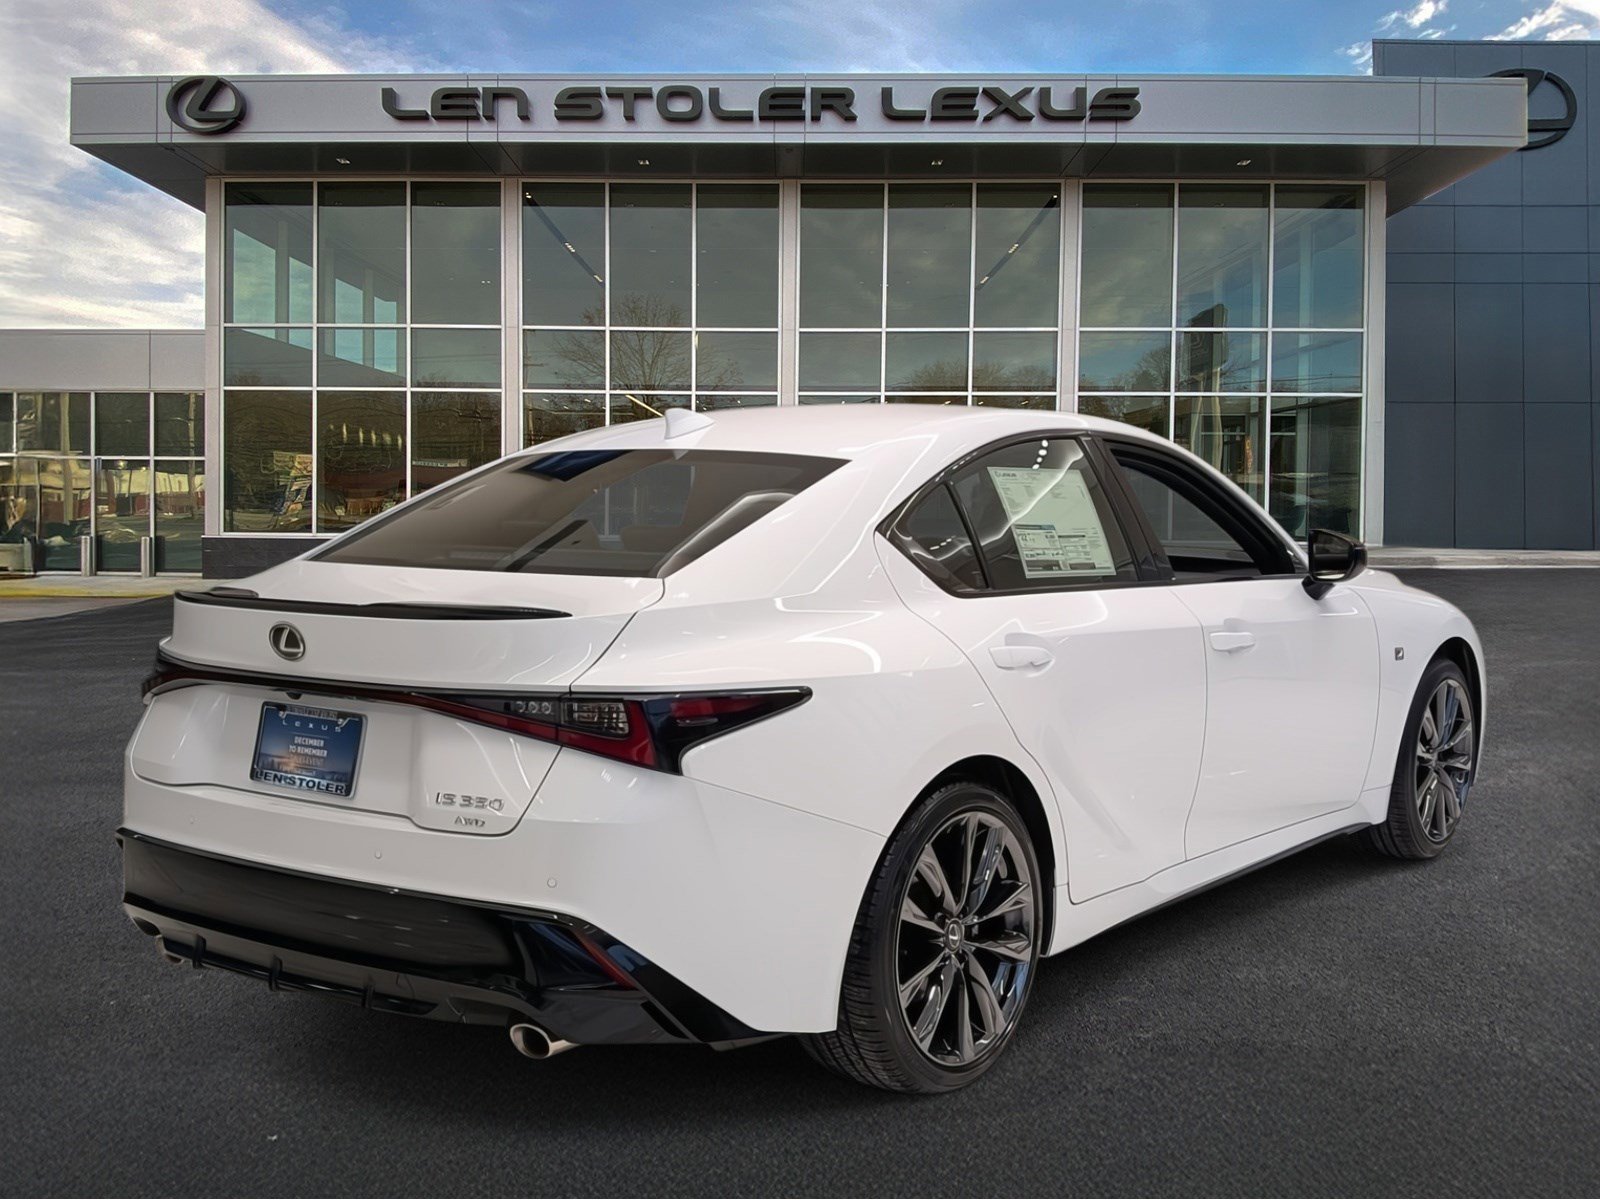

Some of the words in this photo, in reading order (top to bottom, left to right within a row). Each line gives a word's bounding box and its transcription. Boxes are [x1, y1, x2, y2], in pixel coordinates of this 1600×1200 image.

[381, 86, 531, 122] LEN
[553, 85, 859, 122] STOLER
[881, 86, 1142, 122] LEXUS
[282, 720, 341, 732] LEXUS
[294, 736, 325, 747] DECEMBER
[289, 744, 297, 753] TO
[297, 746, 328, 757] REMEMBER
[255, 770, 284, 784] LEN
[286, 775, 345, 794] STOLER
[435, 792, 457, 806] IS
[454, 815, 486, 828] AWD
